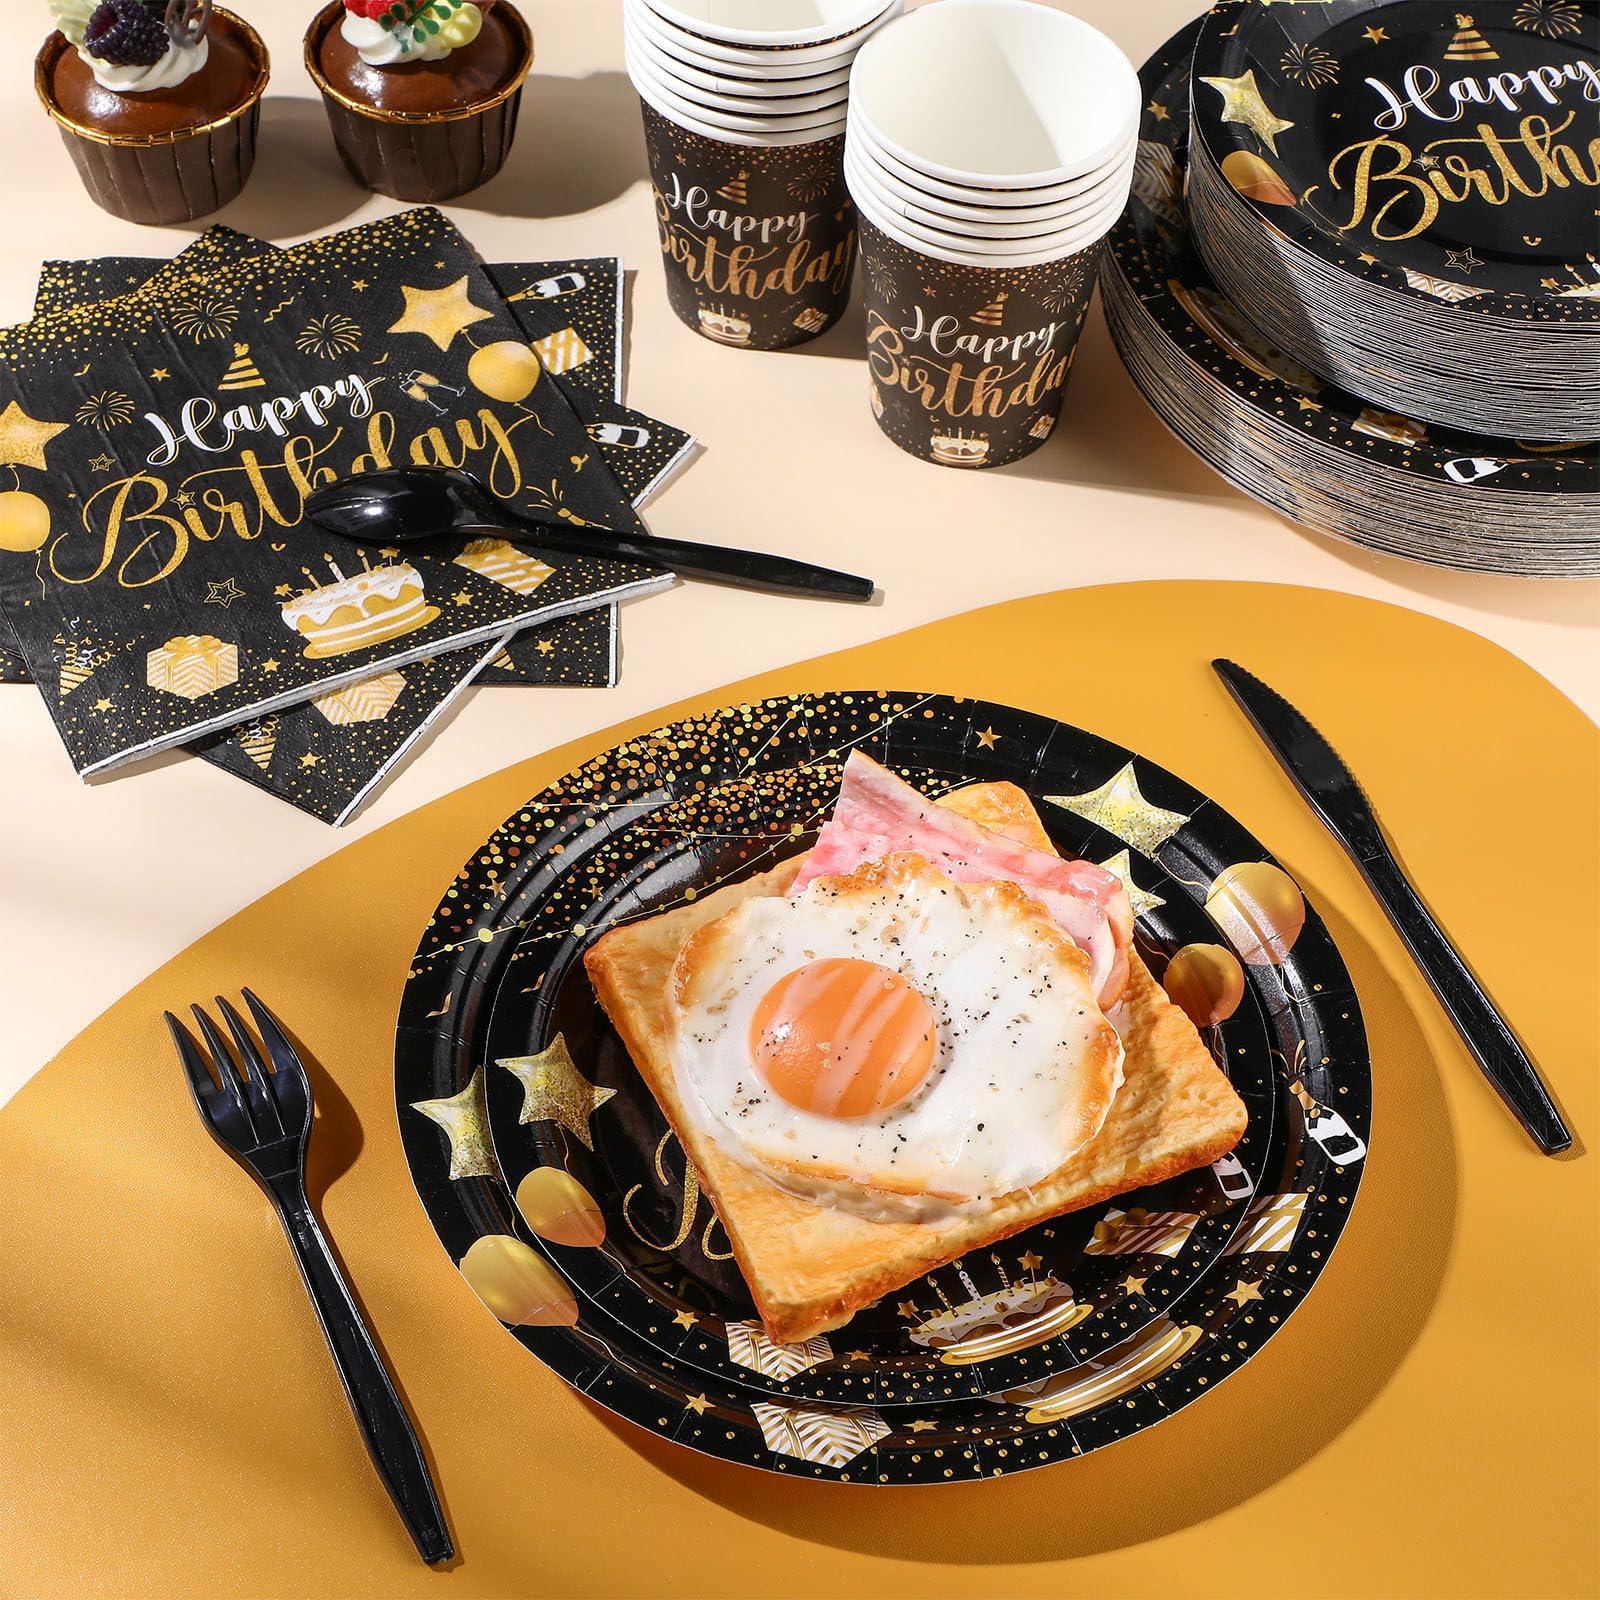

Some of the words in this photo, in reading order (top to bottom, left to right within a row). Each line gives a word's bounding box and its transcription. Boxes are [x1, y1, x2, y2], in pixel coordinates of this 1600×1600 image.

[1364, 60, 1600, 130] Happy
[665, 172, 821, 244] Happy
[1303, 110, 1600, 241] Birth
[867, 310, 1077, 418] Birthda
[900, 305, 1067, 363] Happy
[146, 372, 386, 467] Happy
